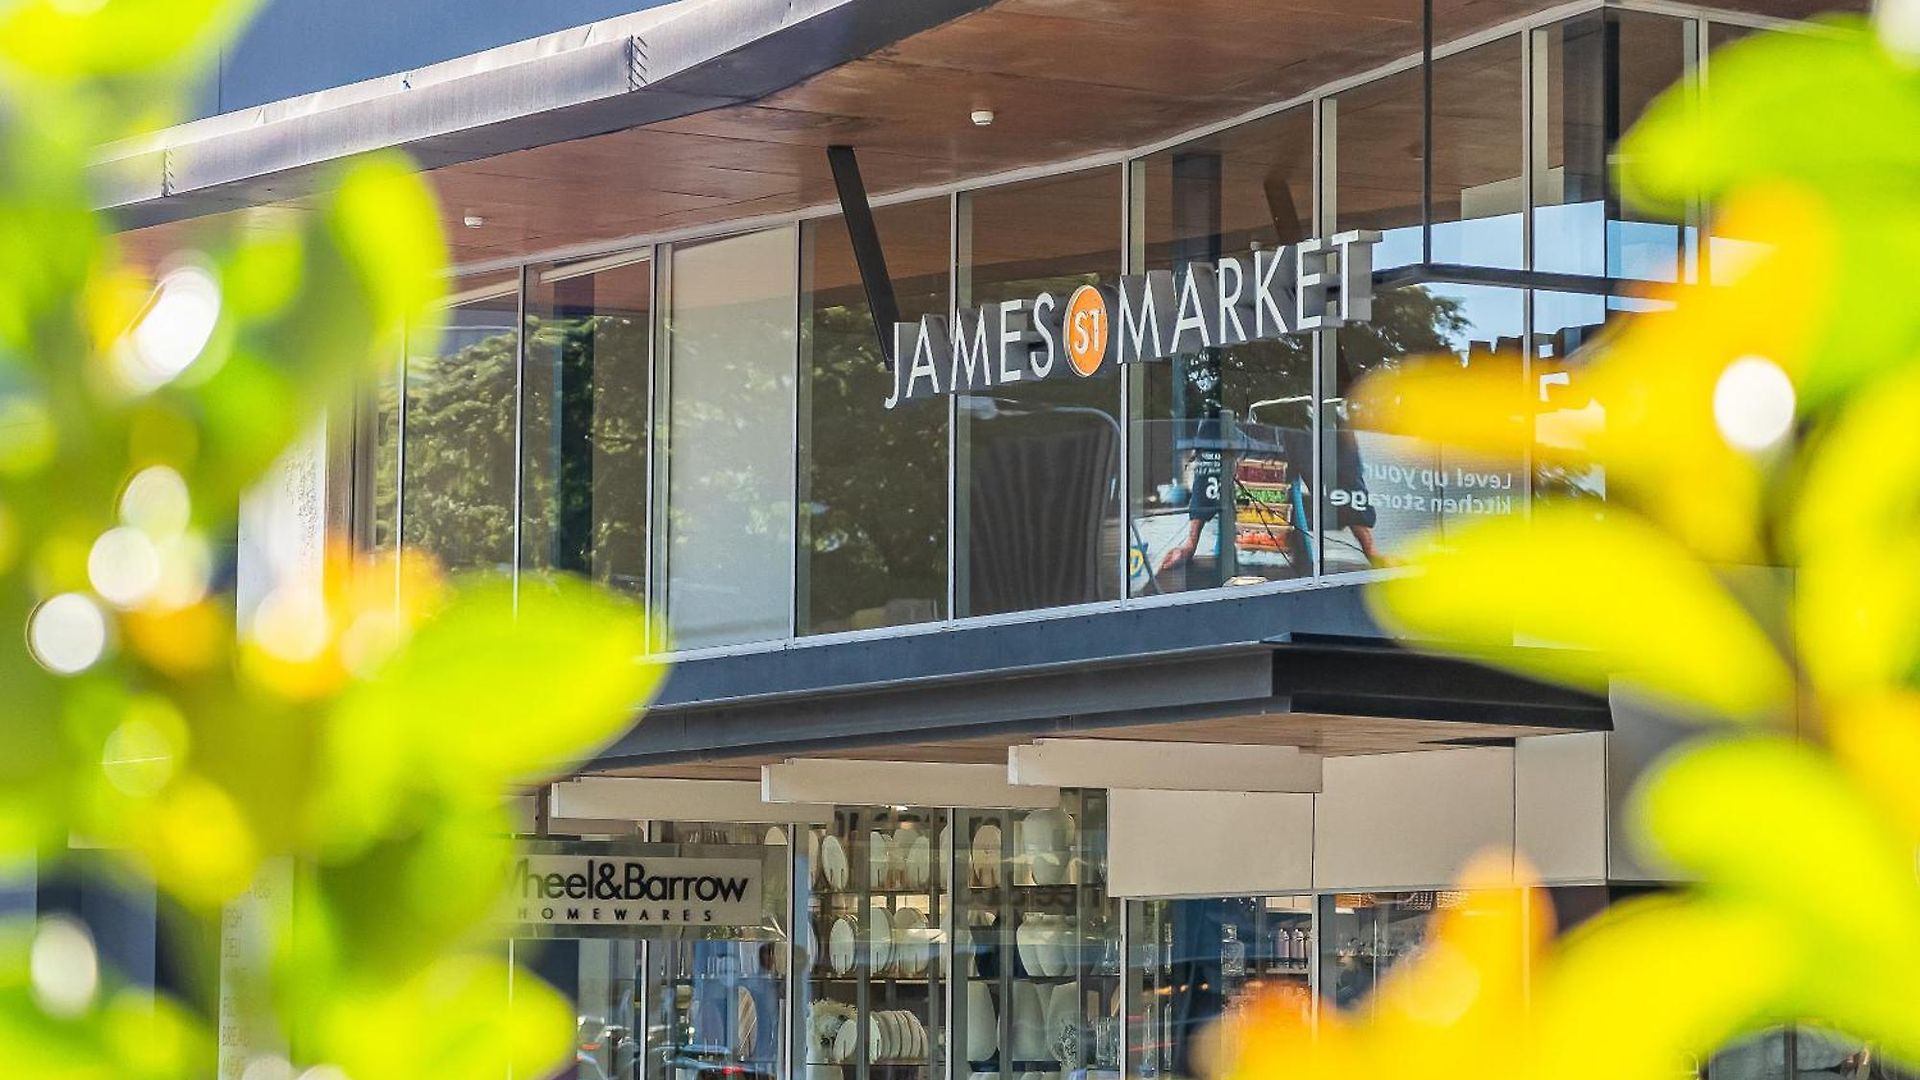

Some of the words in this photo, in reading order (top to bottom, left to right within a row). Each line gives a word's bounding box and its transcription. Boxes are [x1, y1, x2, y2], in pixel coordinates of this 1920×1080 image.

[884, 291, 1055, 409] JAMES
[1073, 308, 1106, 355] ST
[1116, 230, 1362, 364] MARKET
[517, 907, 713, 922] HOMEWARES
